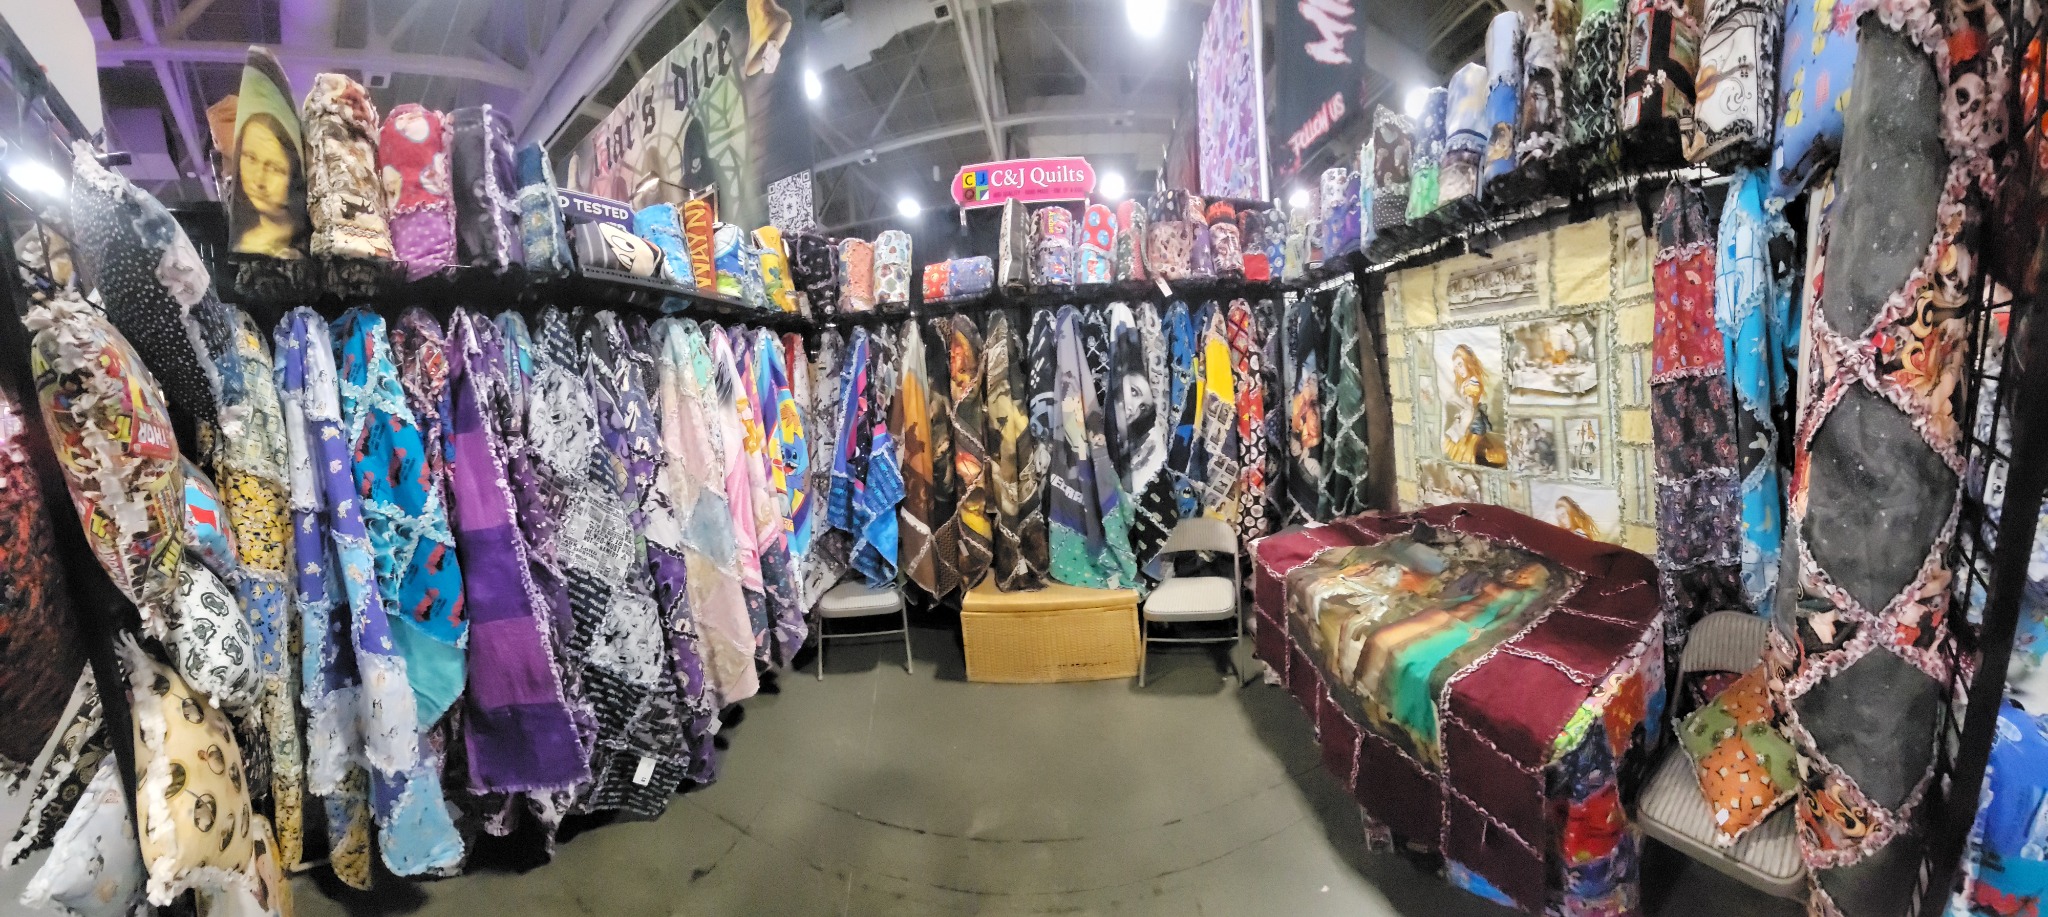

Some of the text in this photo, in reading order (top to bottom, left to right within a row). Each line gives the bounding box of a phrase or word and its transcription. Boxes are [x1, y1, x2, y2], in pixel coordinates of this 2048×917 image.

[671, 27, 732, 111] dice
[1288, 91, 1346, 157] FOLLOW US
[990, 165, 1085, 188] C&J Quilts
[573, 197, 629, 220] TESTED
[138, 421, 169, 449] THOR
